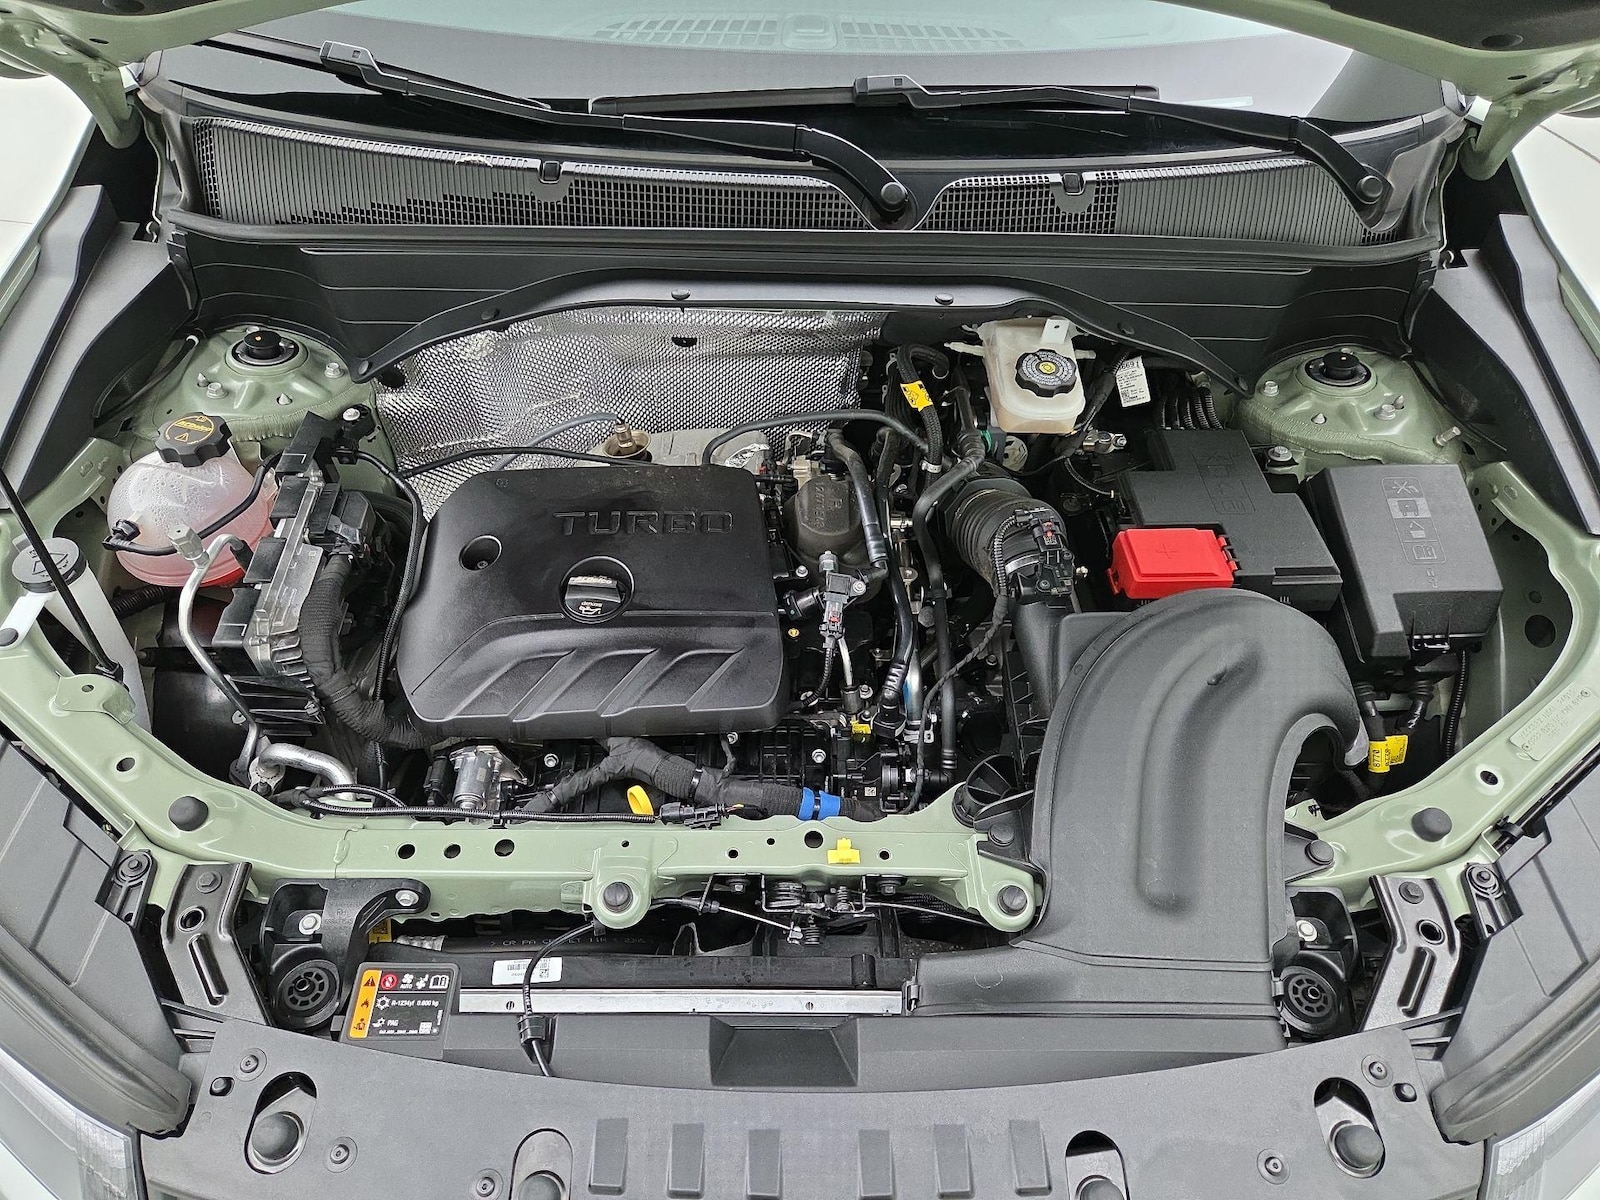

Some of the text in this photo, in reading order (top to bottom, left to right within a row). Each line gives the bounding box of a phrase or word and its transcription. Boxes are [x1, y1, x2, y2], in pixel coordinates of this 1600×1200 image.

[553, 510, 734, 536] TURBO
[391, 999, 415, 1008] R-1234yf
[432, 999, 439, 1008] kg
[387, 1019, 399, 1027] PAG
